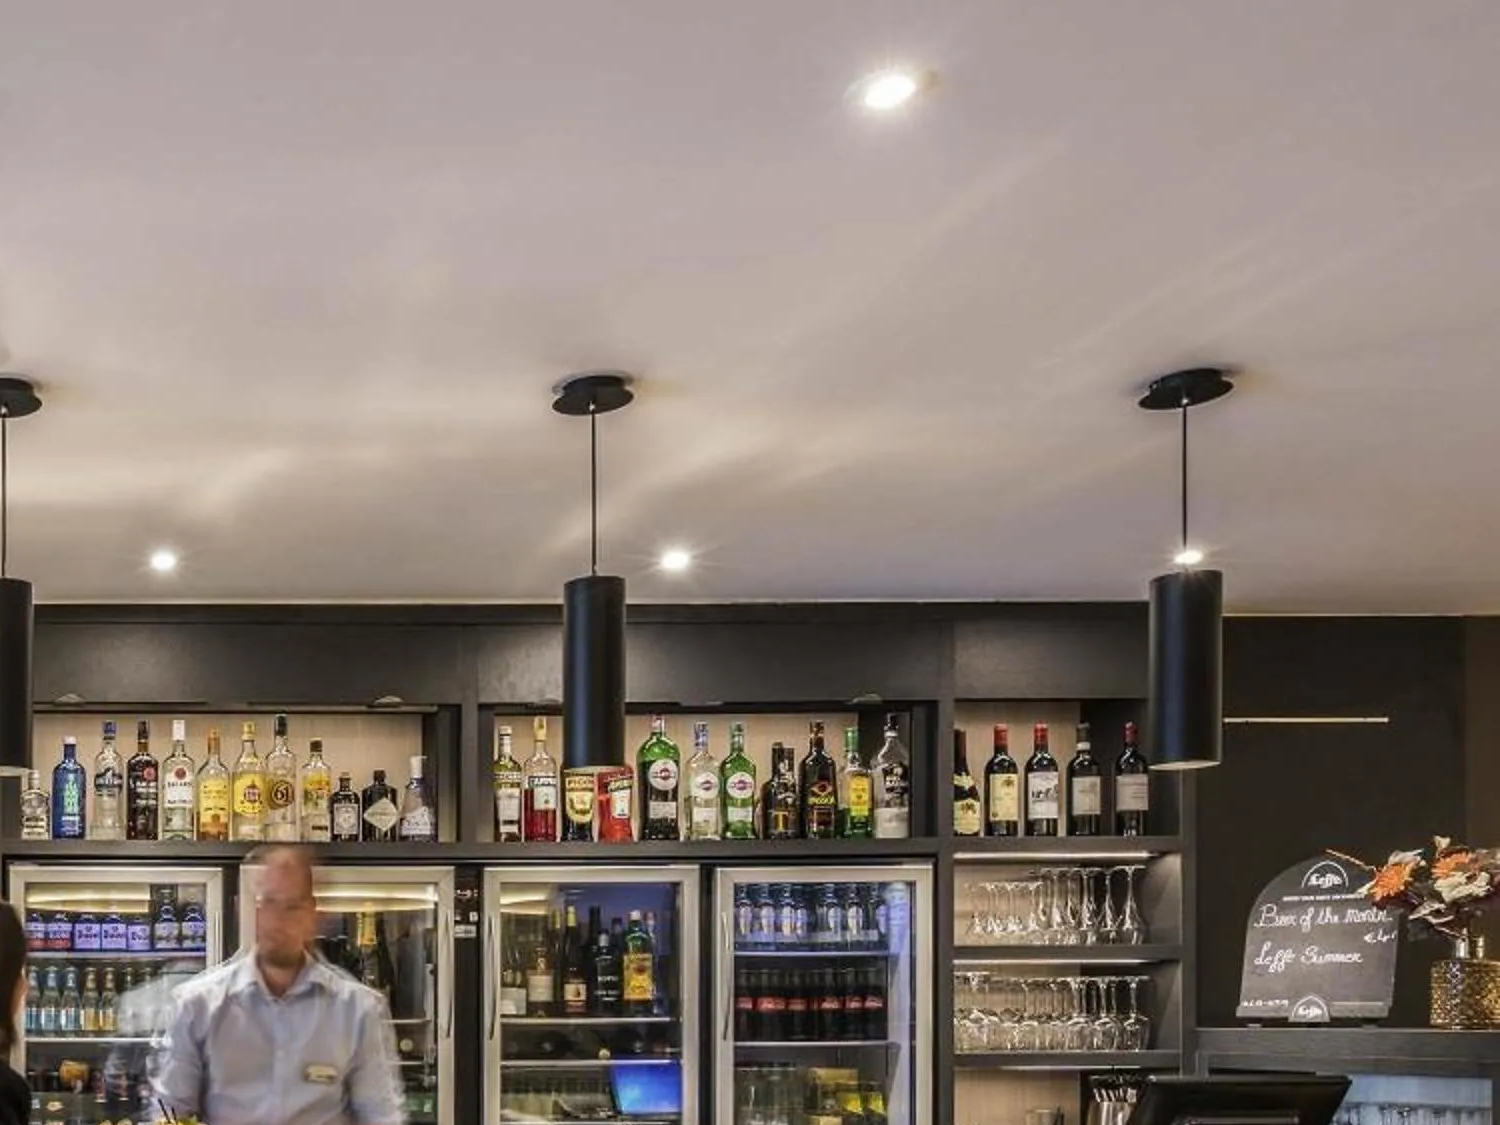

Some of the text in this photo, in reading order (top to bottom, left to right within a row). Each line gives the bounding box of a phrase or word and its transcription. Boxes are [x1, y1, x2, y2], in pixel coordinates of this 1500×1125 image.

[1299, 906, 1315, 933] of
[1316, 906, 1339, 925] the
[1254, 941, 1364, 972] Leffe Summer
